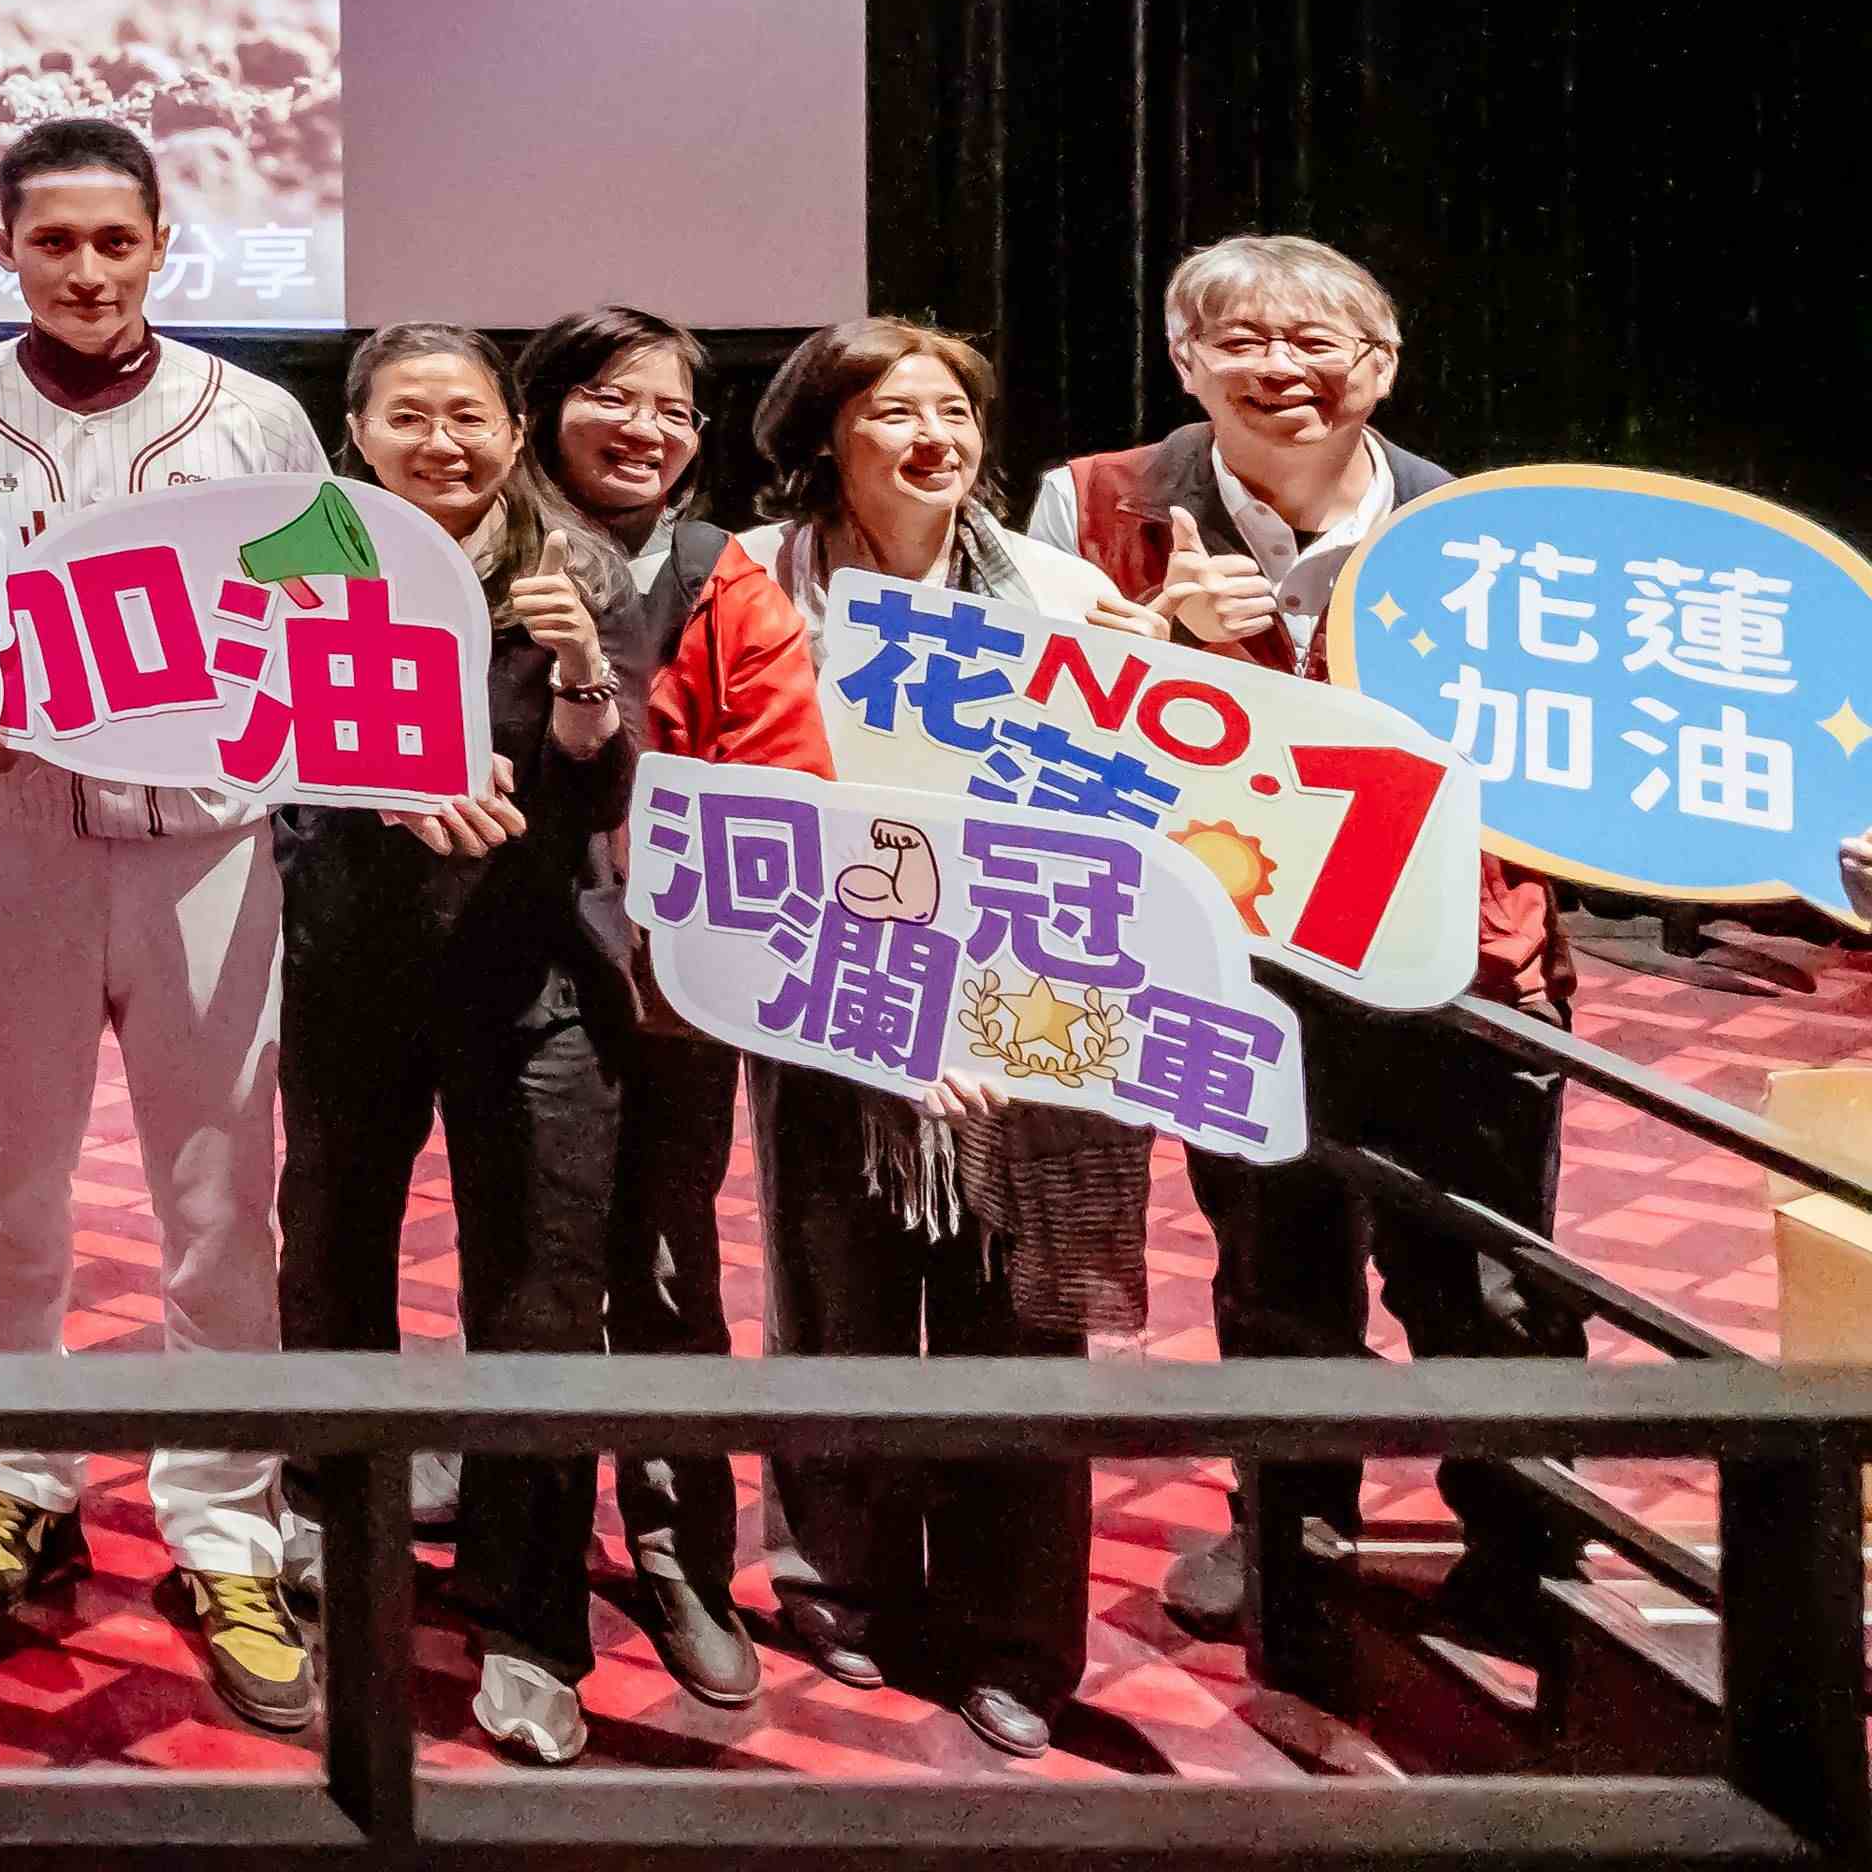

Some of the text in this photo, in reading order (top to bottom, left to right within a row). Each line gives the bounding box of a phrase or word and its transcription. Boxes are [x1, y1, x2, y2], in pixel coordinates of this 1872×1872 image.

[1441, 534, 1799, 696] 花蓮
[1024, 632, 1448, 972] NO.1
[1438, 664, 1796, 834] 加油
[648, 784, 1284, 1144] 洄瀾冠軍
